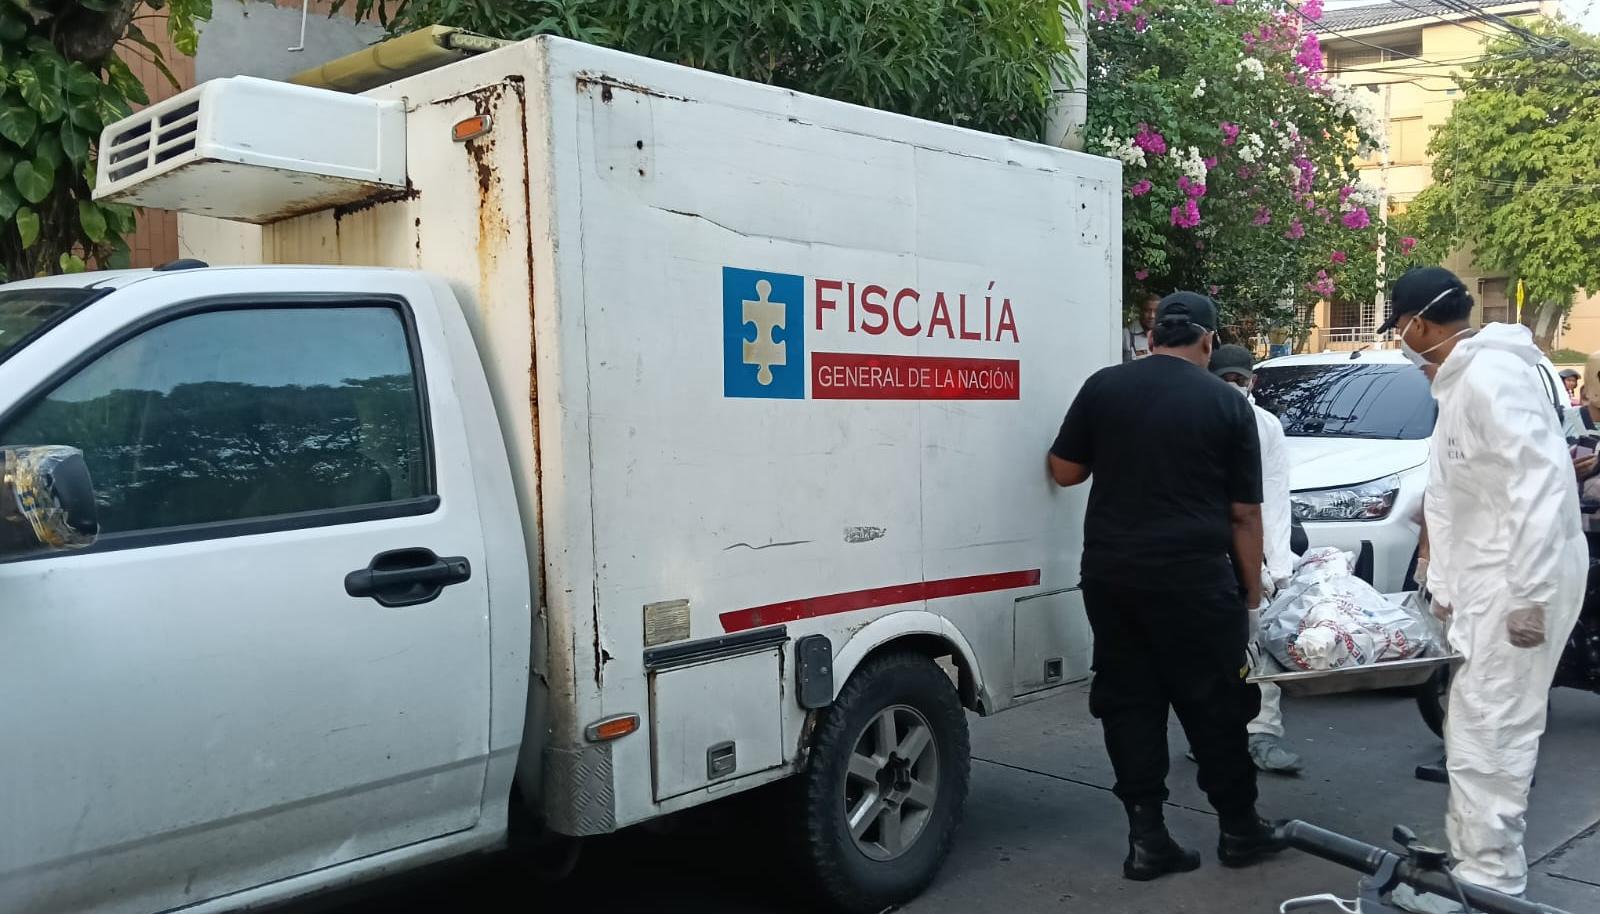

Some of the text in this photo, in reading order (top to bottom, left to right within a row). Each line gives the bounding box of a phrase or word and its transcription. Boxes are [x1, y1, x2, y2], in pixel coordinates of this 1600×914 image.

[814, 279, 1020, 343] FISCALÍA
[818, 365, 1014, 390] GENERAL DE LA NACIÓN
